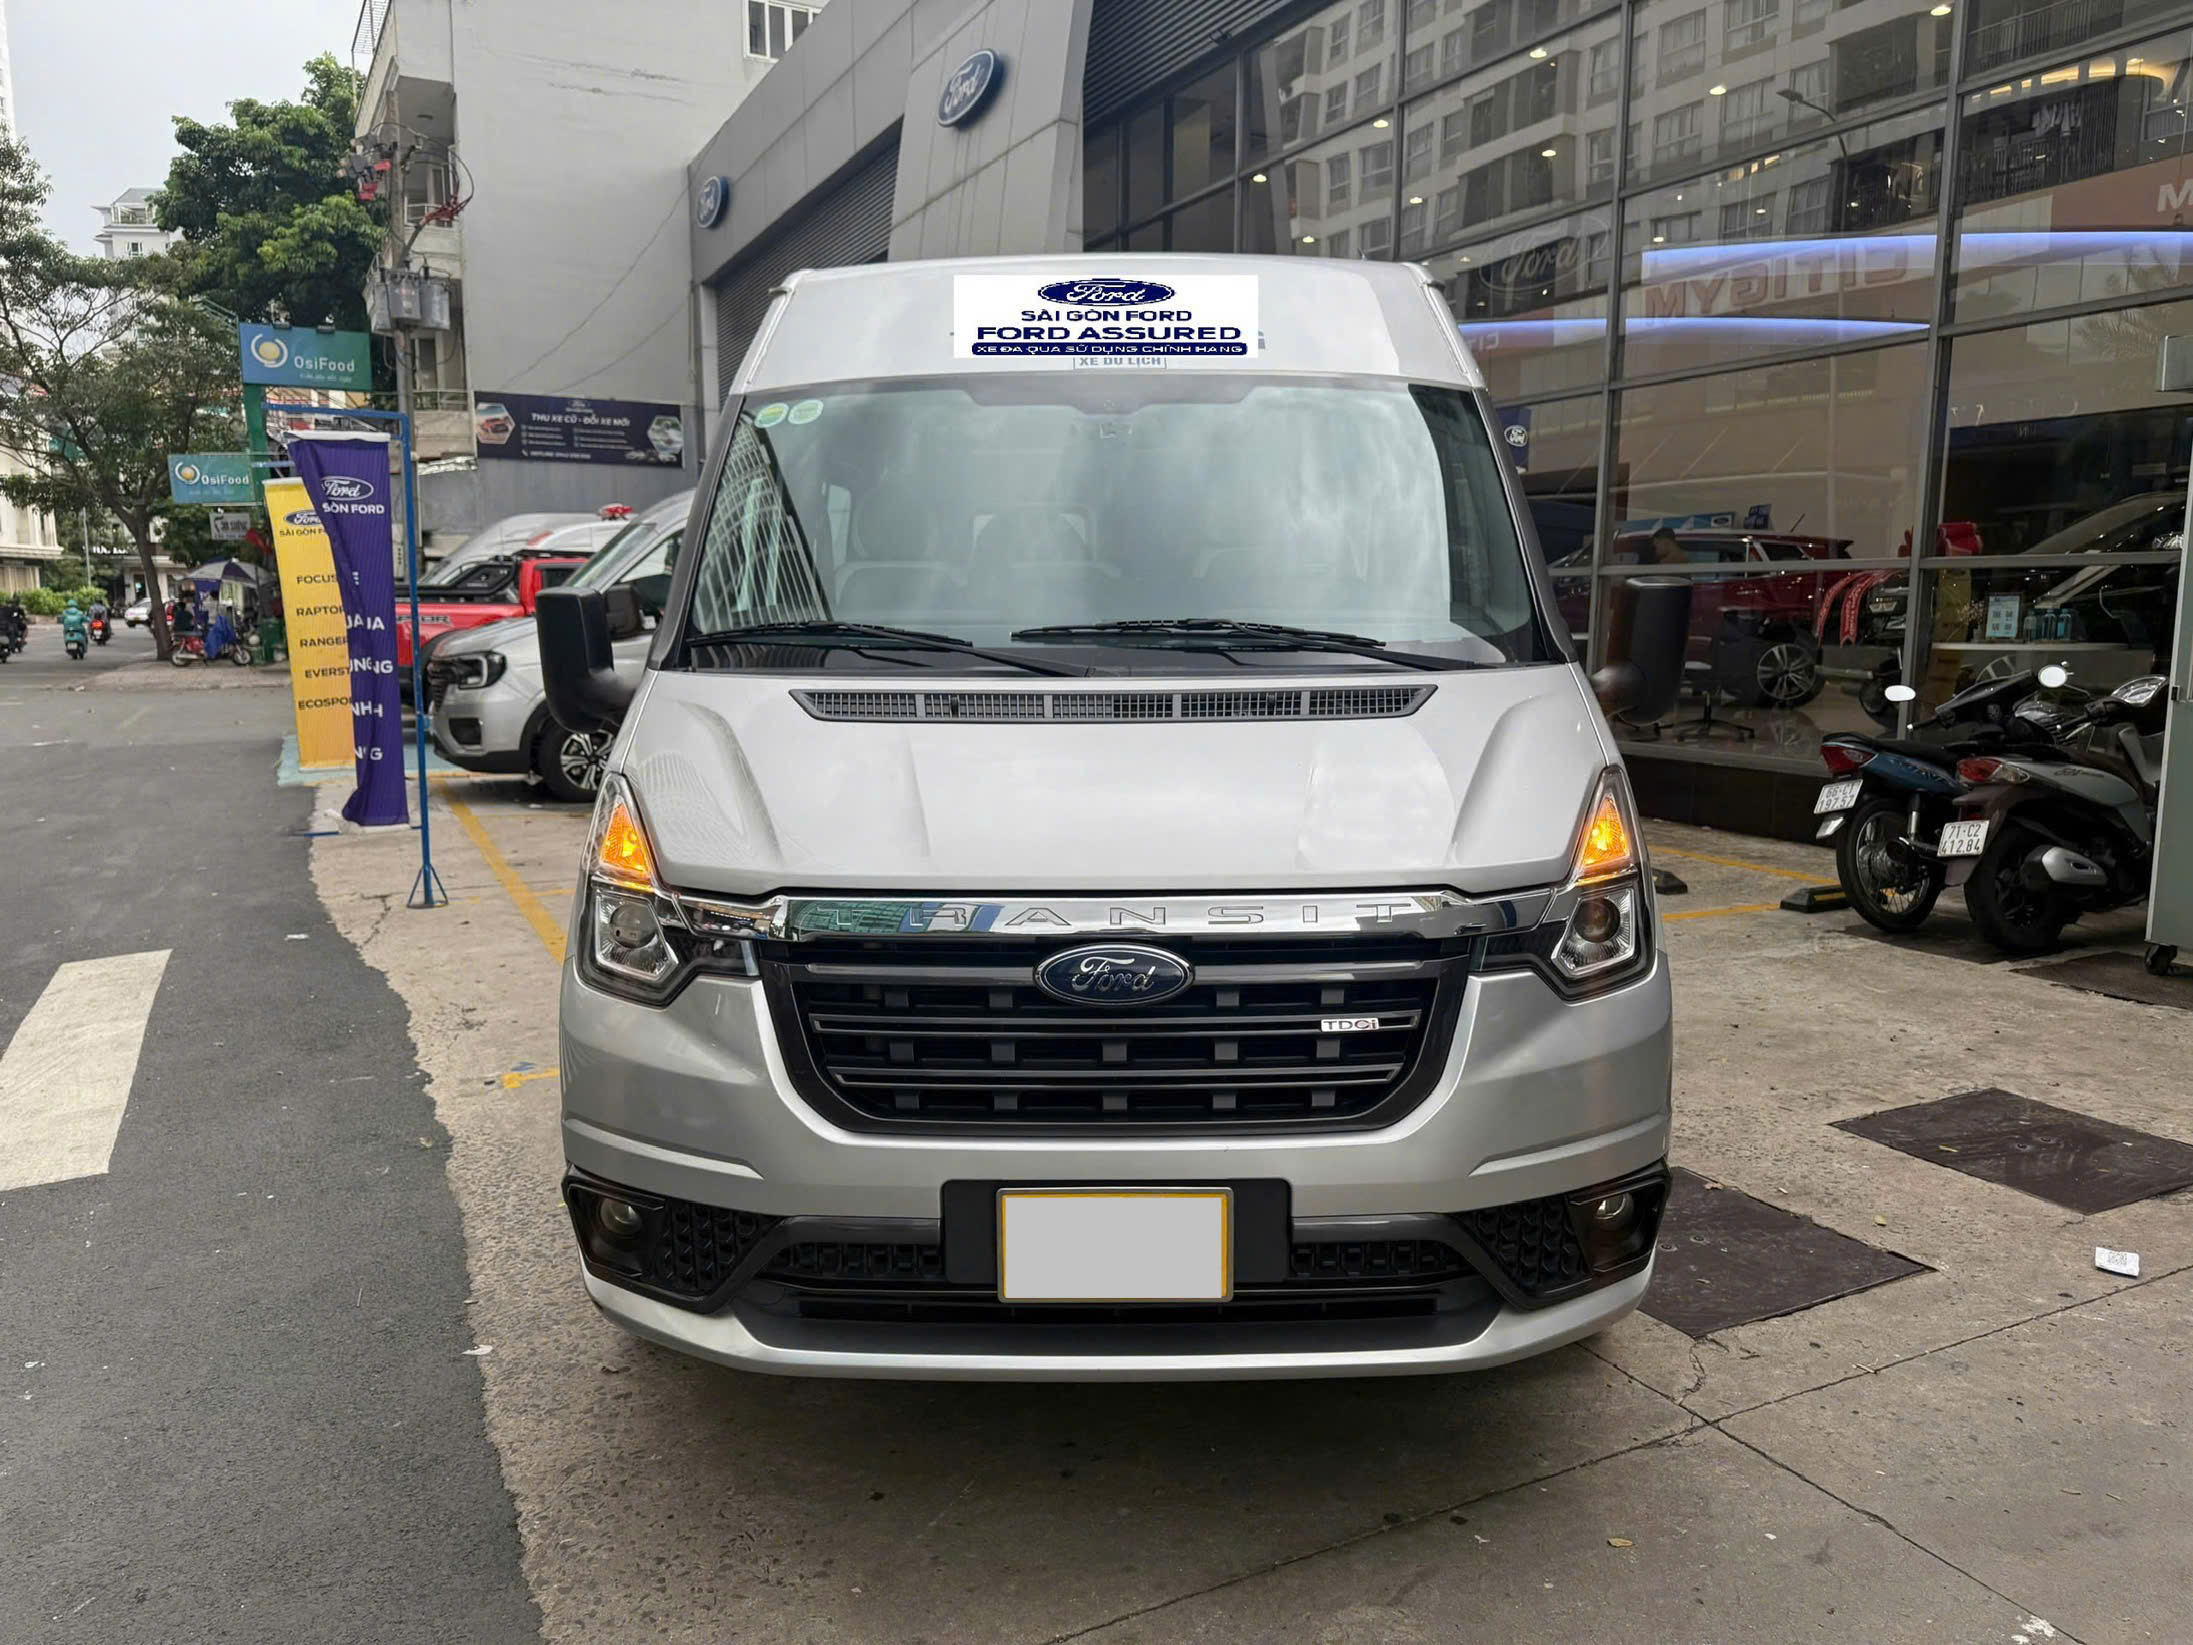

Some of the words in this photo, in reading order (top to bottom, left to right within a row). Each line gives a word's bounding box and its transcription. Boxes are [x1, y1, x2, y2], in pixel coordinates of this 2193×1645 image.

[293, 355, 356, 373] OsiFood
[1079, 357, 1099, 366] XE
[1103, 357, 1123, 366] DU
[531, 413, 550, 423] THU
[551, 415, 564, 424] XE
[201, 474, 250, 486] OsiFood
[351, 503, 385, 515] FORD
[816, 903, 1412, 928] TRANSIT
[1323, 1020, 1377, 1030] TDCi
